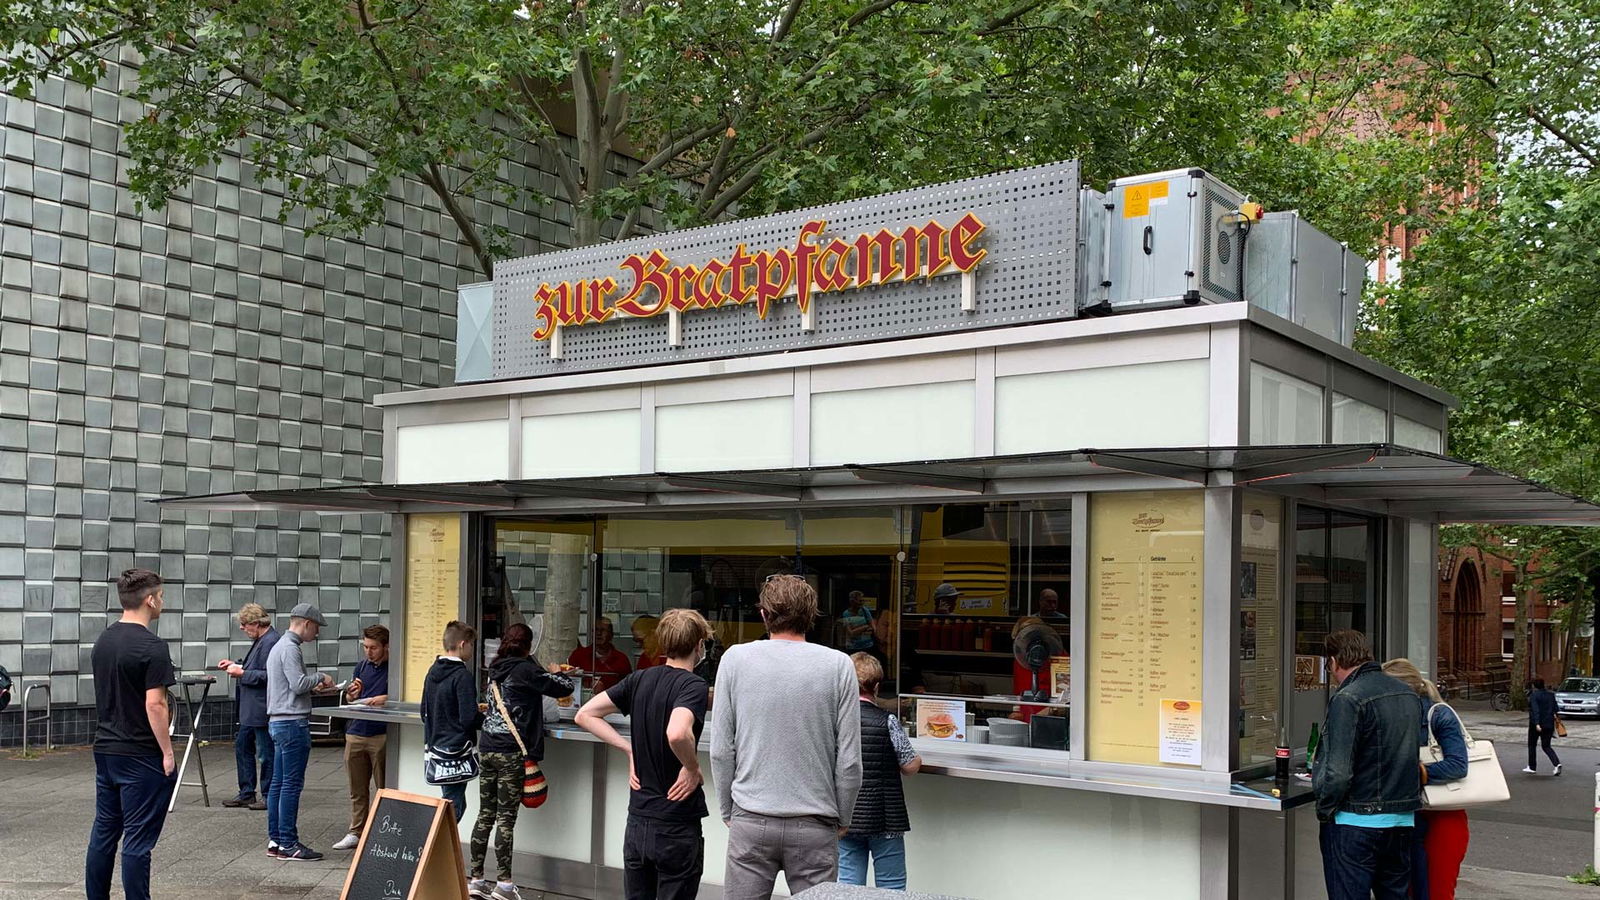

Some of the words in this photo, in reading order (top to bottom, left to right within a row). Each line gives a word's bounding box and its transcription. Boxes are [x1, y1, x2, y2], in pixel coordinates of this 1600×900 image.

[532, 275, 618, 341] zur
[616, 212, 988, 320] Bratpfanne
[434, 760, 472, 779] BERLIN
[379, 815, 402, 836] Bitte
